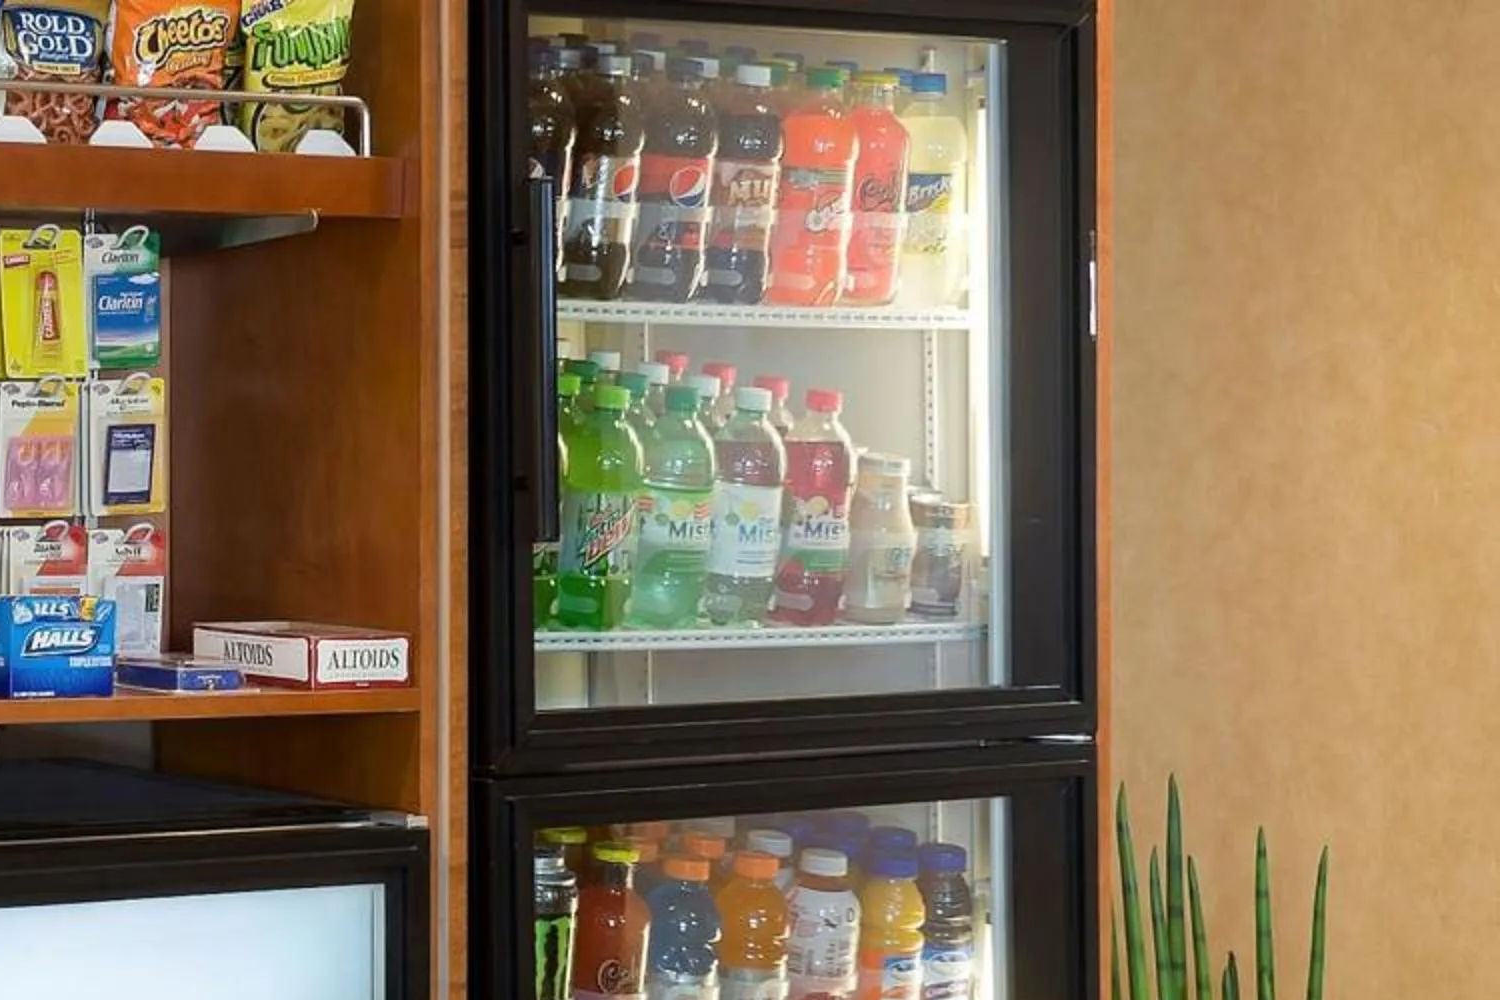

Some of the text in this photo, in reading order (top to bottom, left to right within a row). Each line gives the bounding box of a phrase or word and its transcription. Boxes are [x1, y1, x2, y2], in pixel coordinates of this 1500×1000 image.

[20, 12, 86, 34] ROLD
[18, 30, 93, 57] GOLD
[138, 11, 227, 63] Cheetos
[738, 523, 774, 545] Mis
[30, 629, 96, 650] HALLS
[223, 640, 273, 666] ALTOIDS
[328, 648, 400, 670] ALTOIDS
